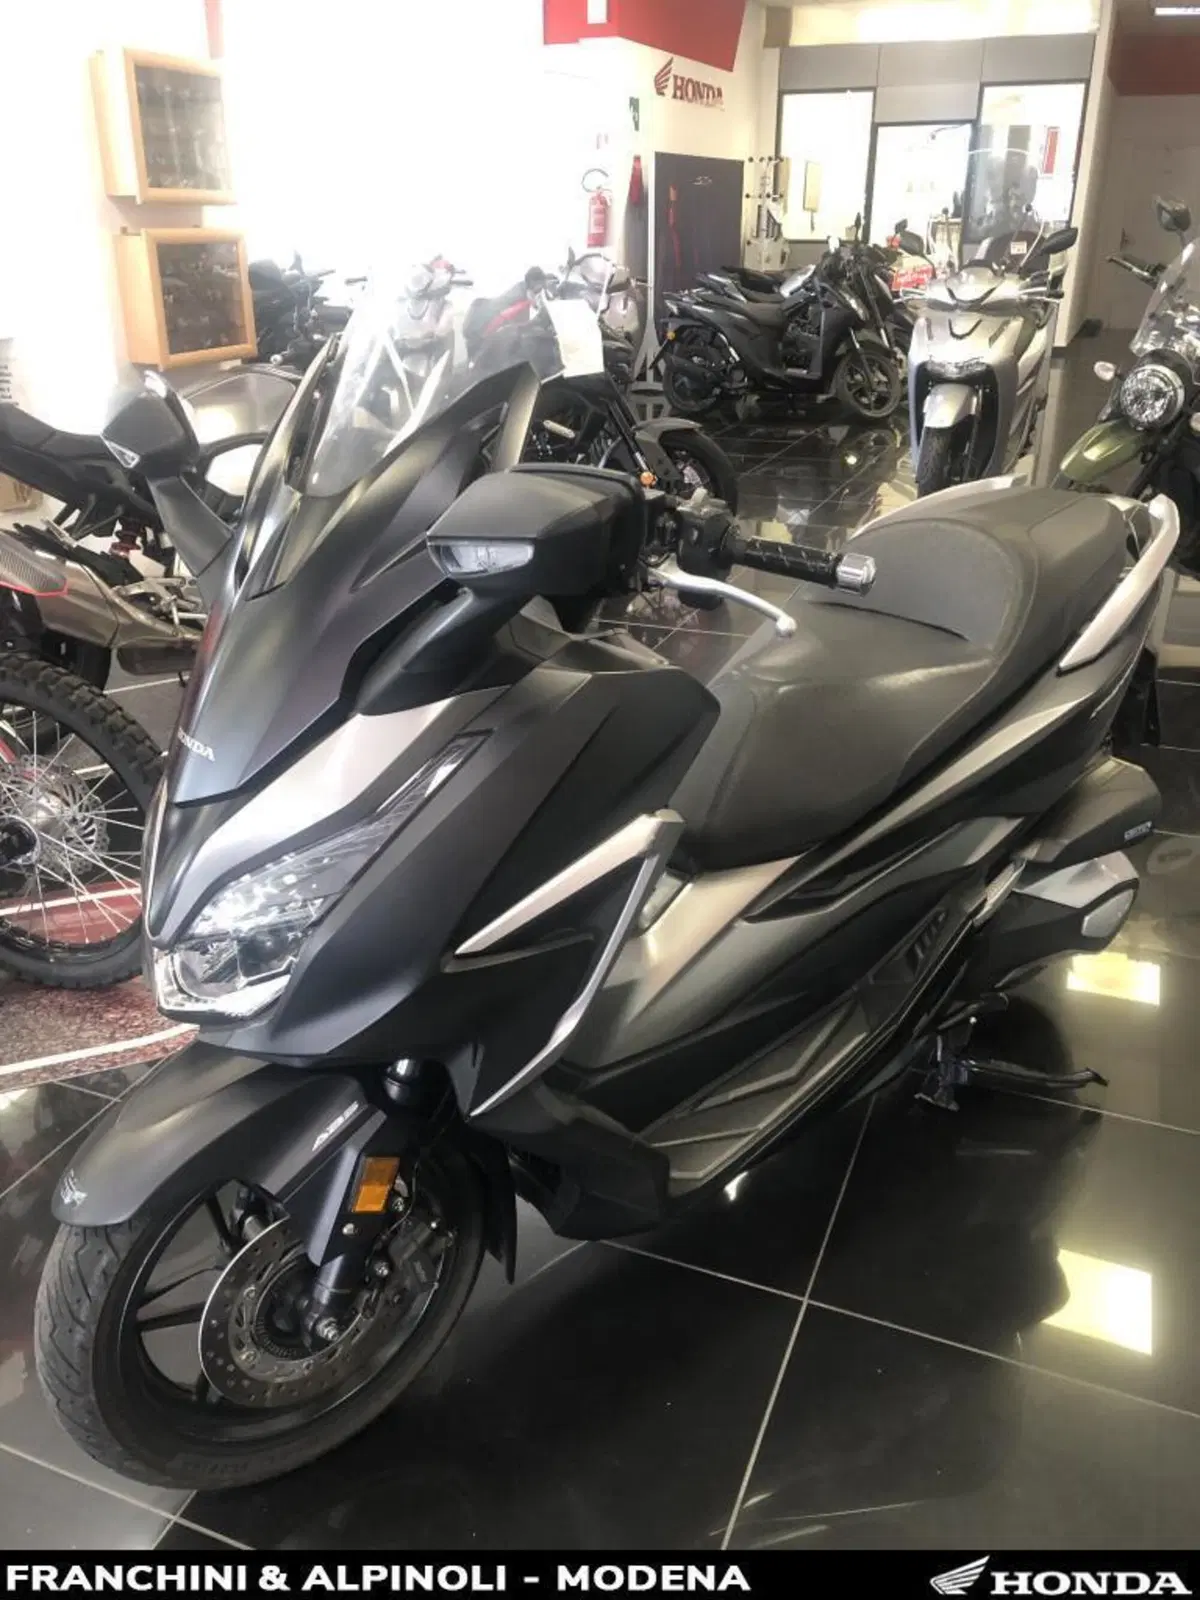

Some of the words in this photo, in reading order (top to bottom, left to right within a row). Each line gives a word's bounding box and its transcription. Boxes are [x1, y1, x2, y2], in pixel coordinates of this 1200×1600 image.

[672, 74, 724, 108] HONDA
[177, 726, 216, 762] ONDA
[311, 1100, 360, 1152] ABS
